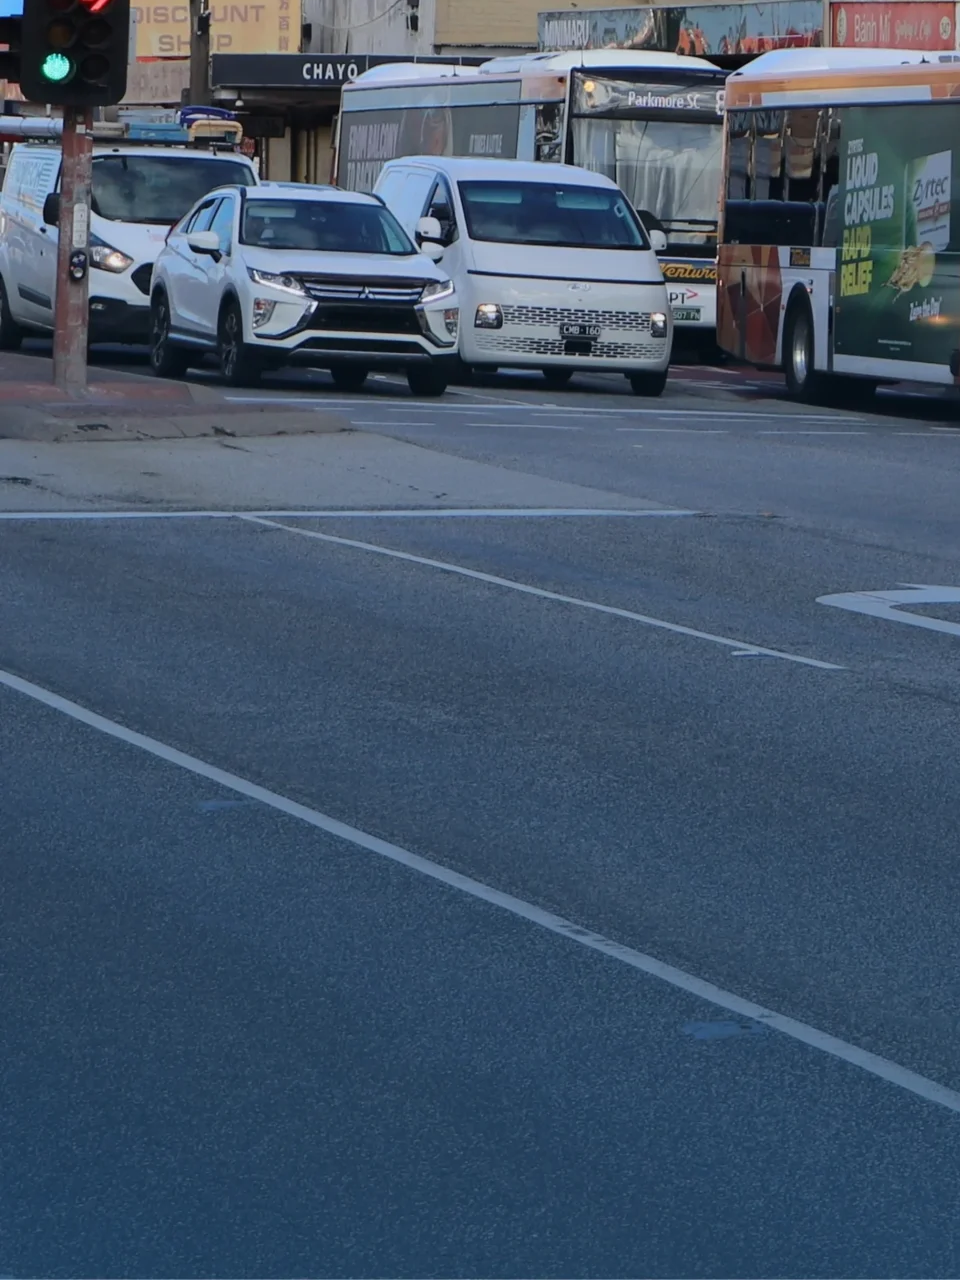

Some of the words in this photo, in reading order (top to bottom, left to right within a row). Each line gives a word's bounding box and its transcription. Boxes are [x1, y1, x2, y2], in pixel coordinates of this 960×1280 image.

[136, 4, 265, 24] DISCUNT
[159, 34, 233, 52] SHP
[628, 91, 684, 108] Parkmore
[846, 152, 878, 190] LIQUID
[844, 184, 895, 226] CAPSULES
[912, 176, 949, 208] Zyrtec
[842, 225, 871, 261] RAPID
[840, 260, 873, 297] RELIEF
